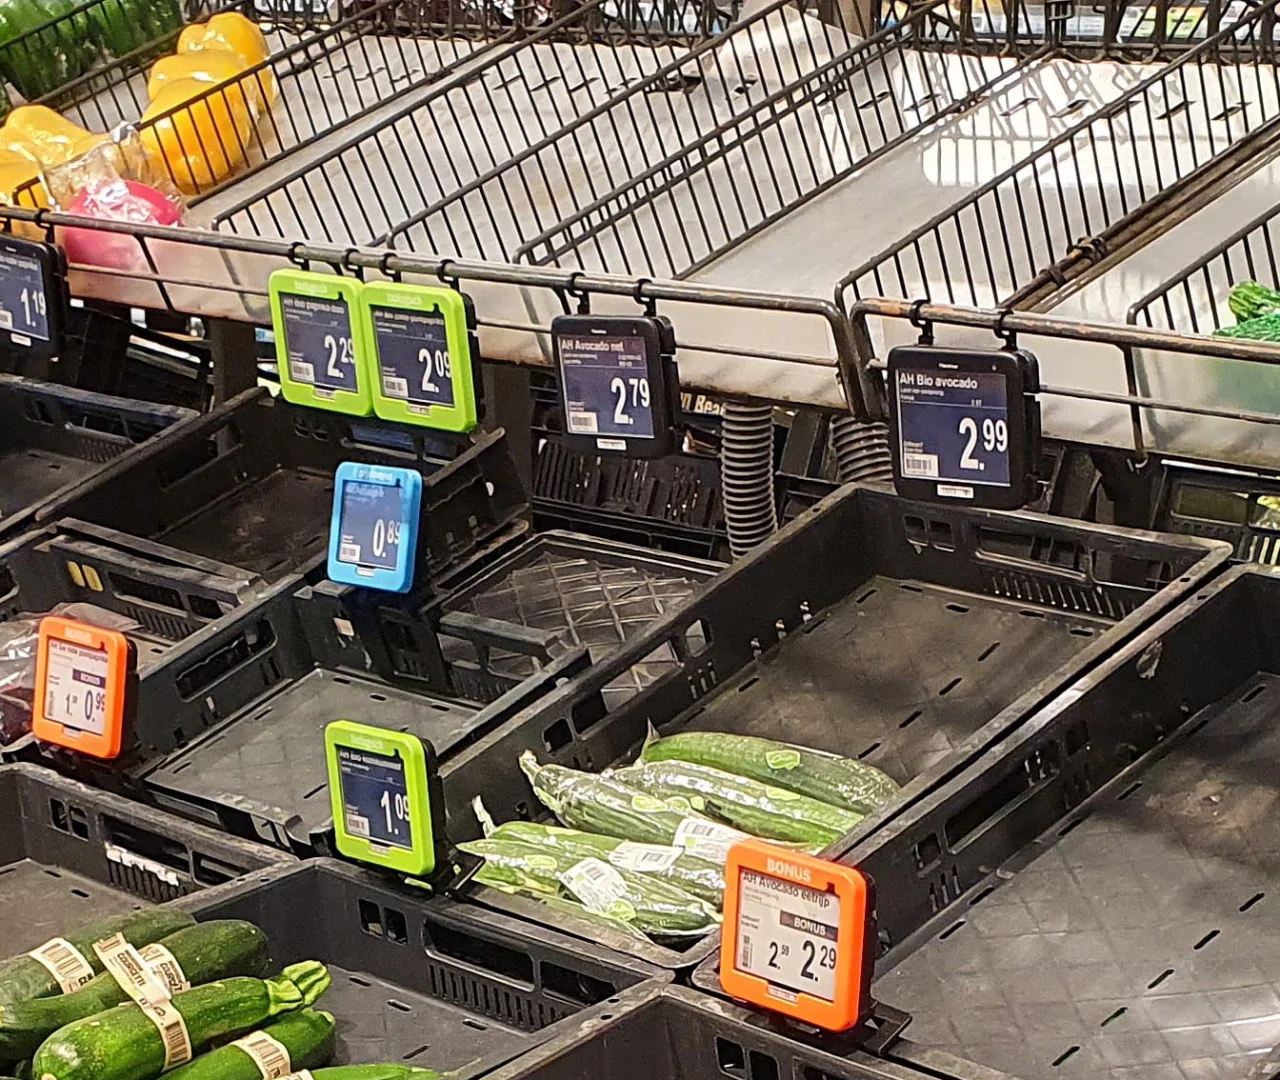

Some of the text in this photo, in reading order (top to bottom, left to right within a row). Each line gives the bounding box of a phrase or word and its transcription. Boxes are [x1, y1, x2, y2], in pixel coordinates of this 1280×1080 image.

[20, 287, 47, 328] 1.19
[611, 376, 651, 426] 2.79
[899, 372, 978, 390] AH Bio avocado
[958, 416, 1009, 472] 2.99
[766, 858, 812, 883] BONUS
[793, 916, 827, 936] BONUS
[799, 940, 838, 983] 2.29
